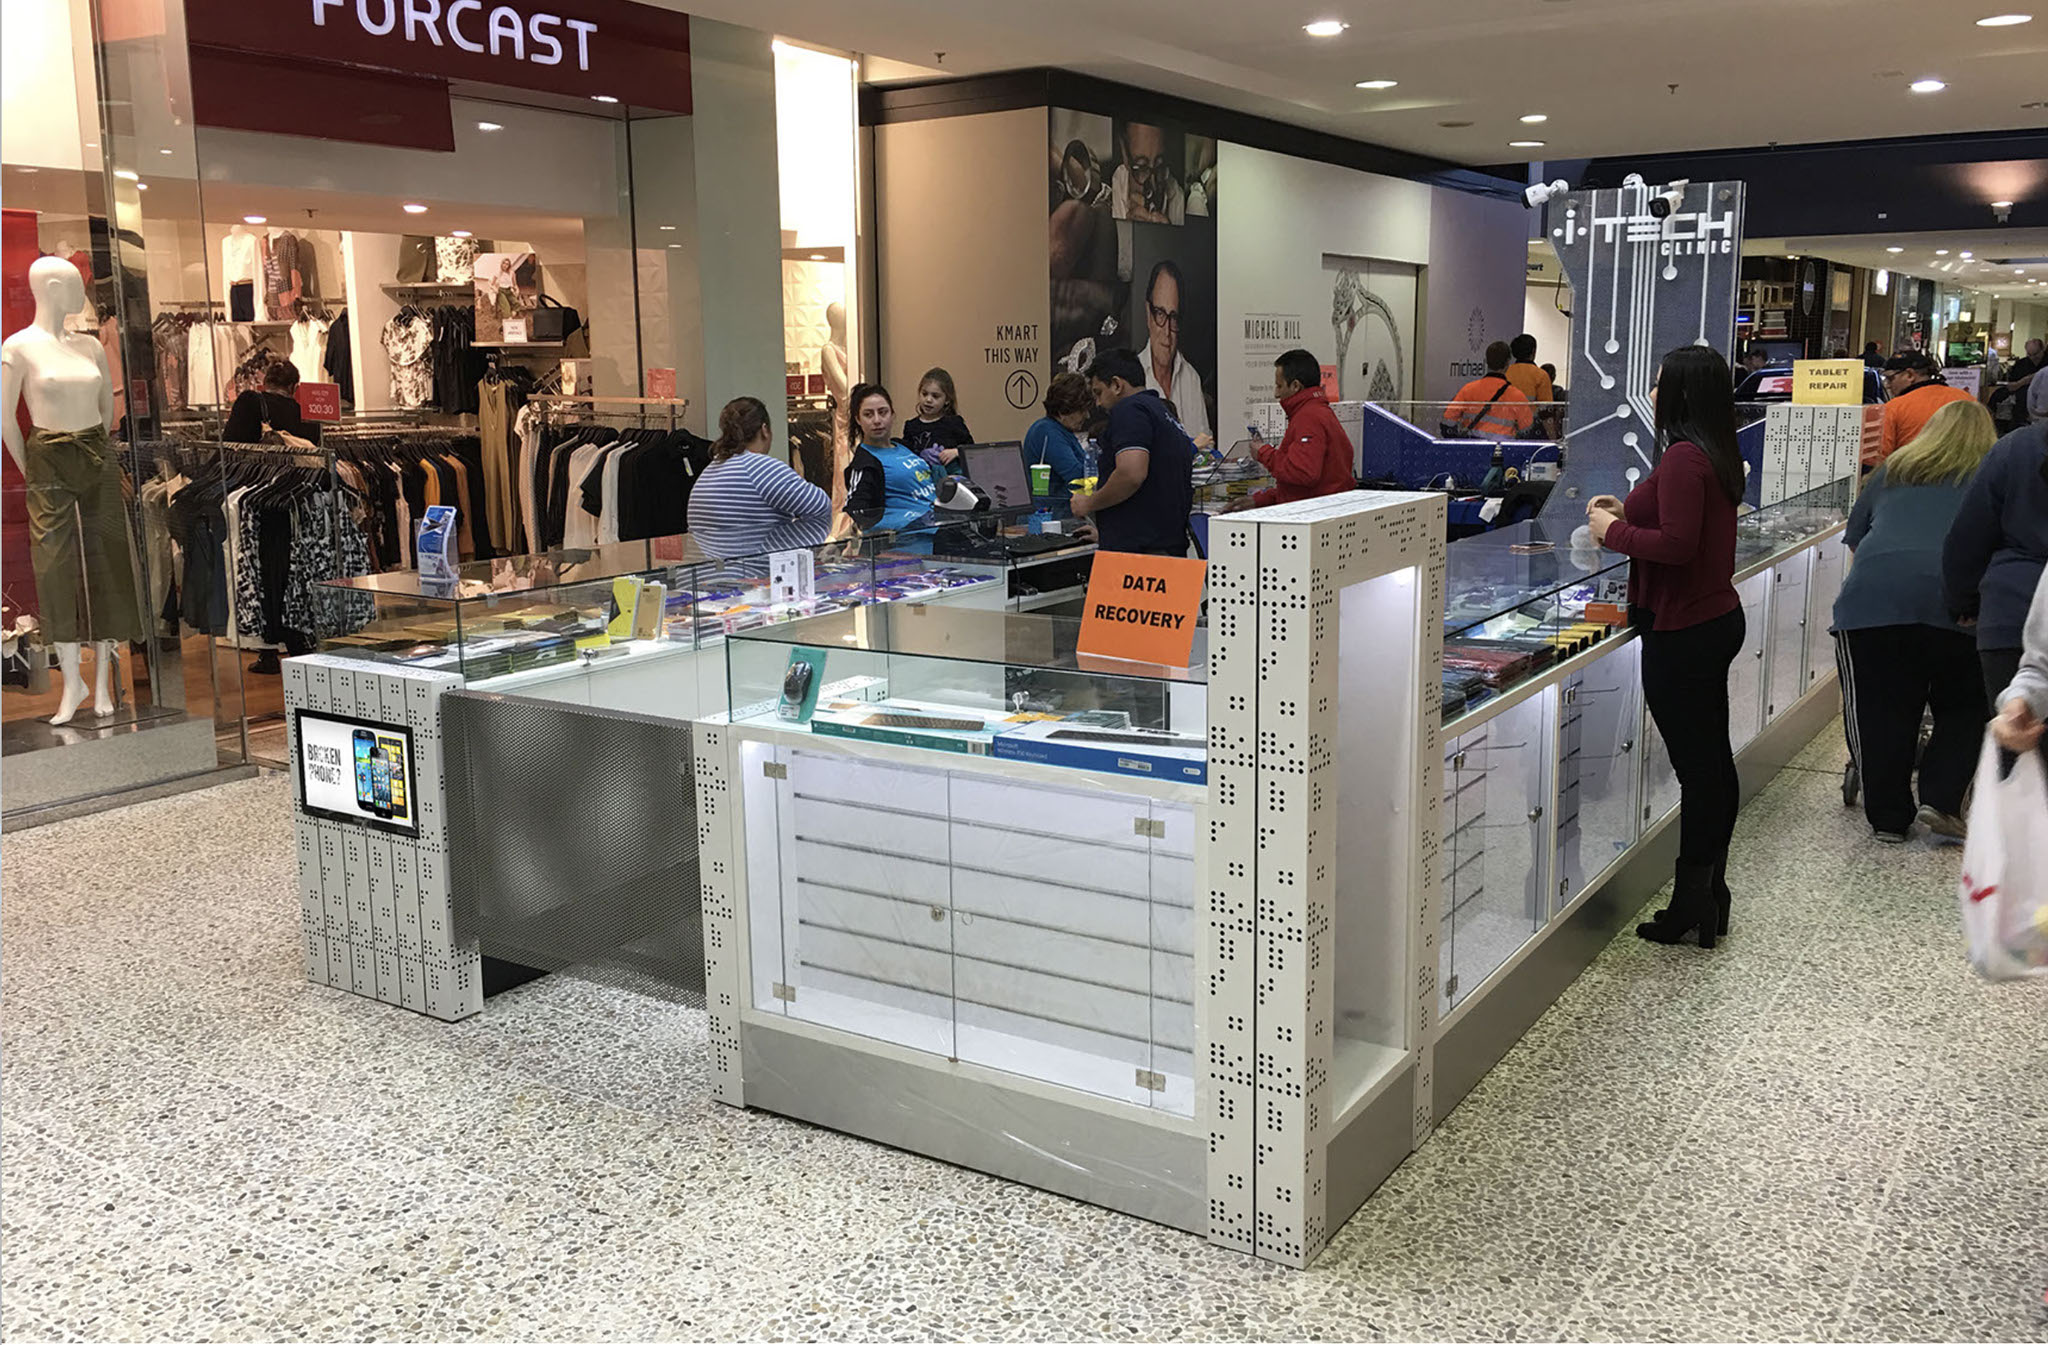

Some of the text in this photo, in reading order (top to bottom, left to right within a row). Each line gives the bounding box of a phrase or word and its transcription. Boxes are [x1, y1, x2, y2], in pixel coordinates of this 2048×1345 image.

[311, 0, 598, 71] FORCAST
[1660, 239, 1732, 256] CLINIC
[996, 324, 1039, 341] KMART
[1244, 319, 1301, 340] MICHAEL HILL
[984, 347, 1039, 364] THIS WAY
[1808, 368, 1850, 376] TABLET
[1808, 382, 1848, 390] REPAIR
[1122, 574, 1167, 594] DATA
[1094, 604, 1186, 630] RECOVERY
[307, 743, 342, 766] BROKEN
[308, 763, 342, 785] PHONE?
